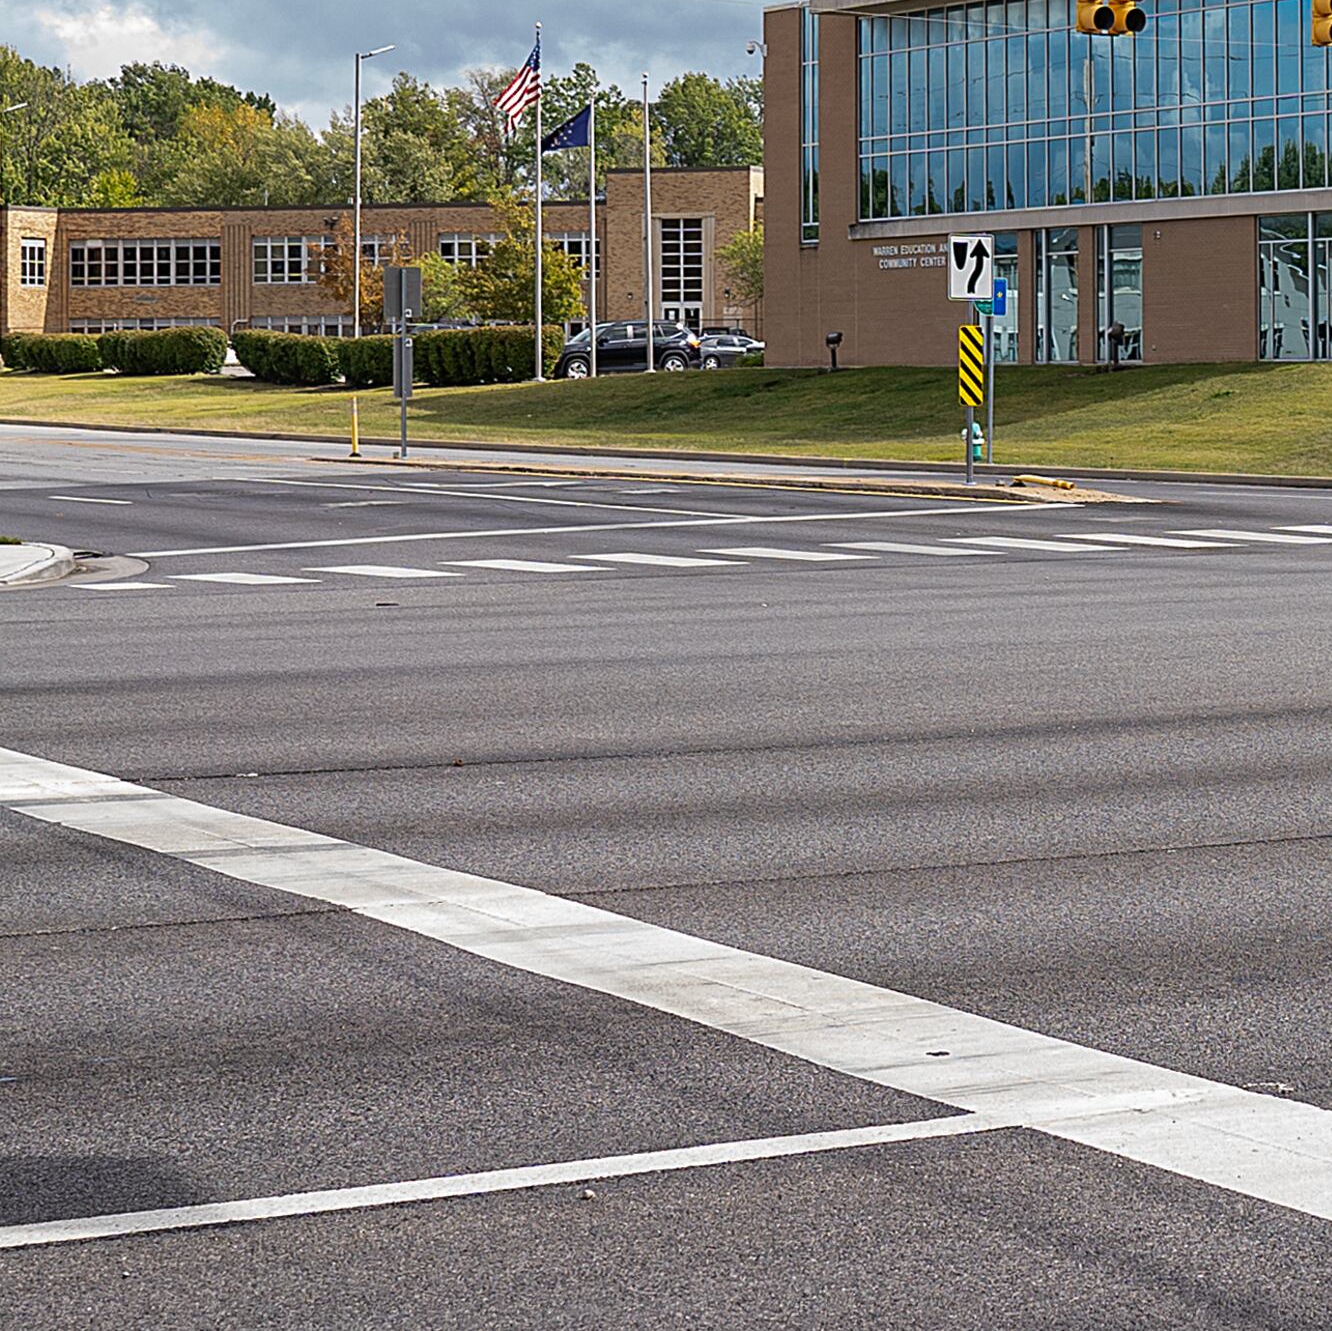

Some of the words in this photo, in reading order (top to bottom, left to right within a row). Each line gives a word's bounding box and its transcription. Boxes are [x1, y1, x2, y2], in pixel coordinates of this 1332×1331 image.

[873, 246, 899, 256] WARREN
[900, 244, 937, 255] EDUCATION
[940, 243, 949, 253] AN
[879, 257, 917, 269] COMMUNITY
[919, 256, 946, 267] CENTER
